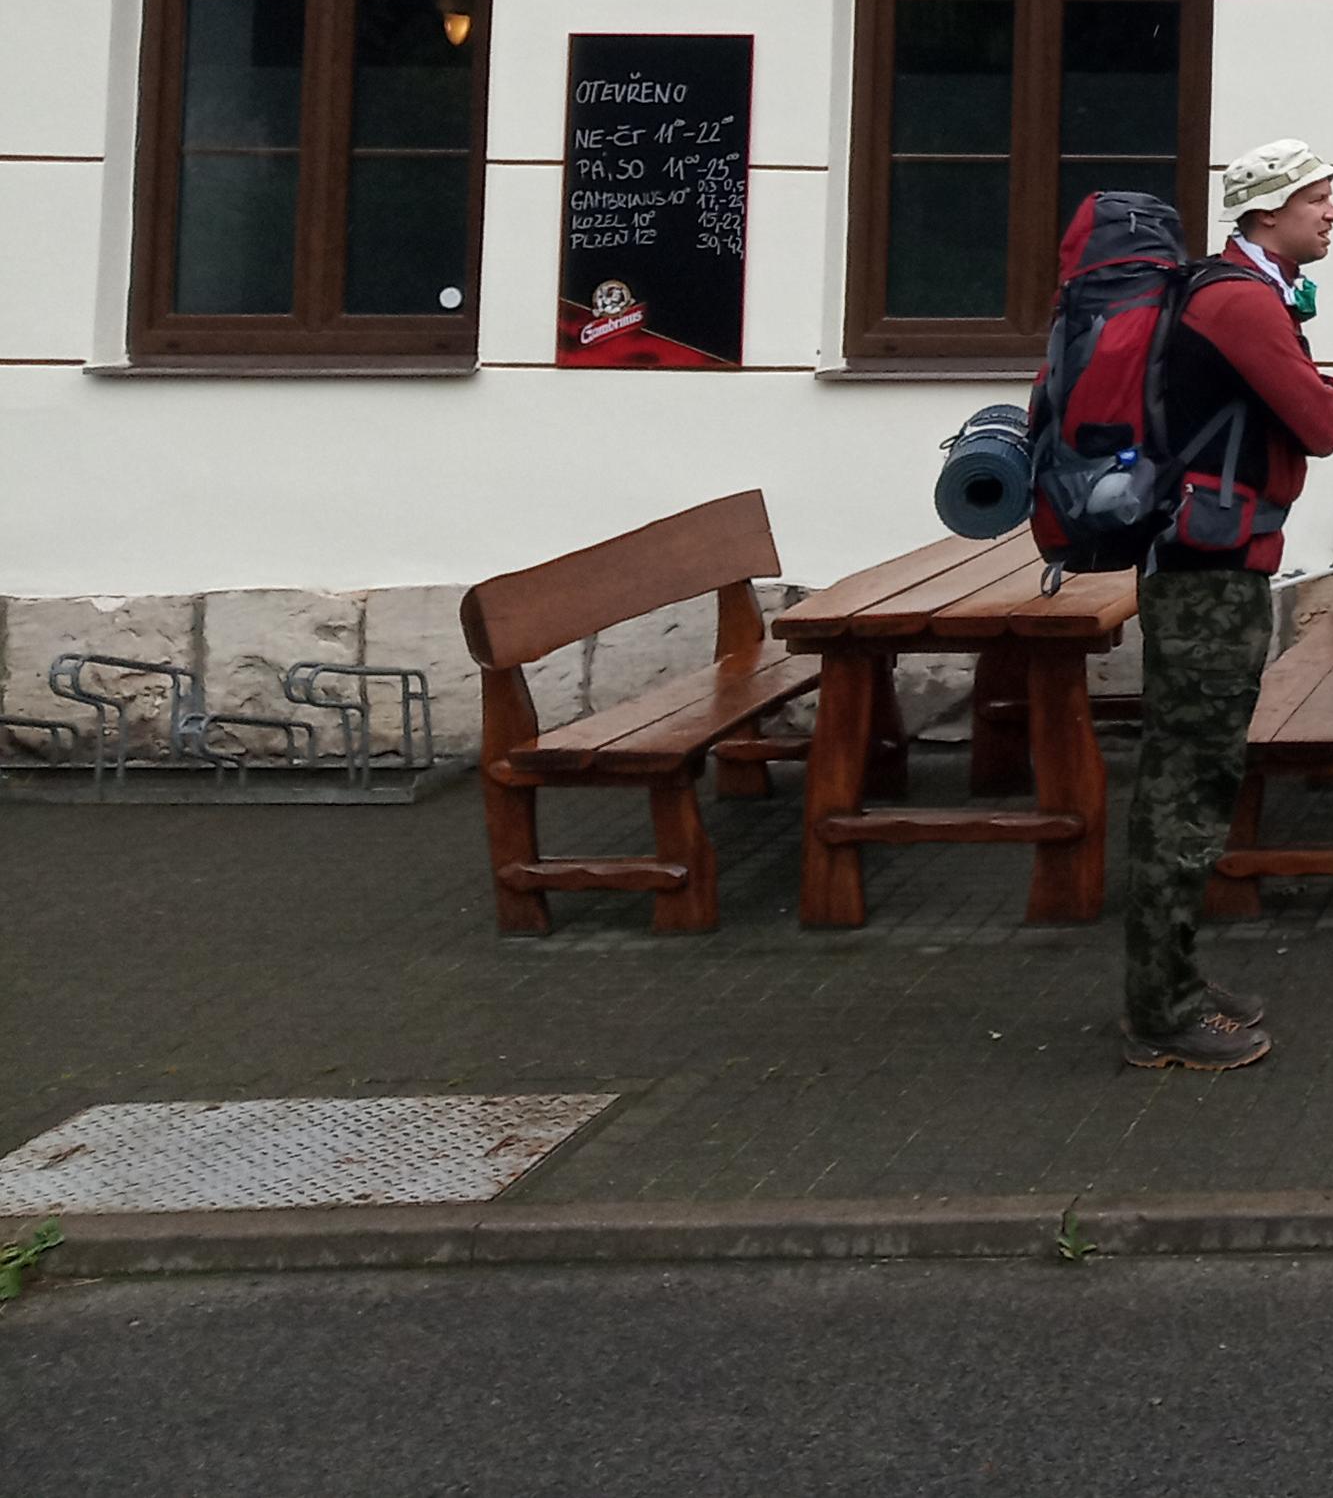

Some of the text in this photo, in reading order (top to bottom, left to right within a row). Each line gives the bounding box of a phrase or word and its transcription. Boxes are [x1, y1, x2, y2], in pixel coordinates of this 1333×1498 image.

[575, 71, 688, 104] OTEVŘENO
[570, 189, 667, 211] GAMBRINUS
[571, 213, 629, 230] KOZEL
